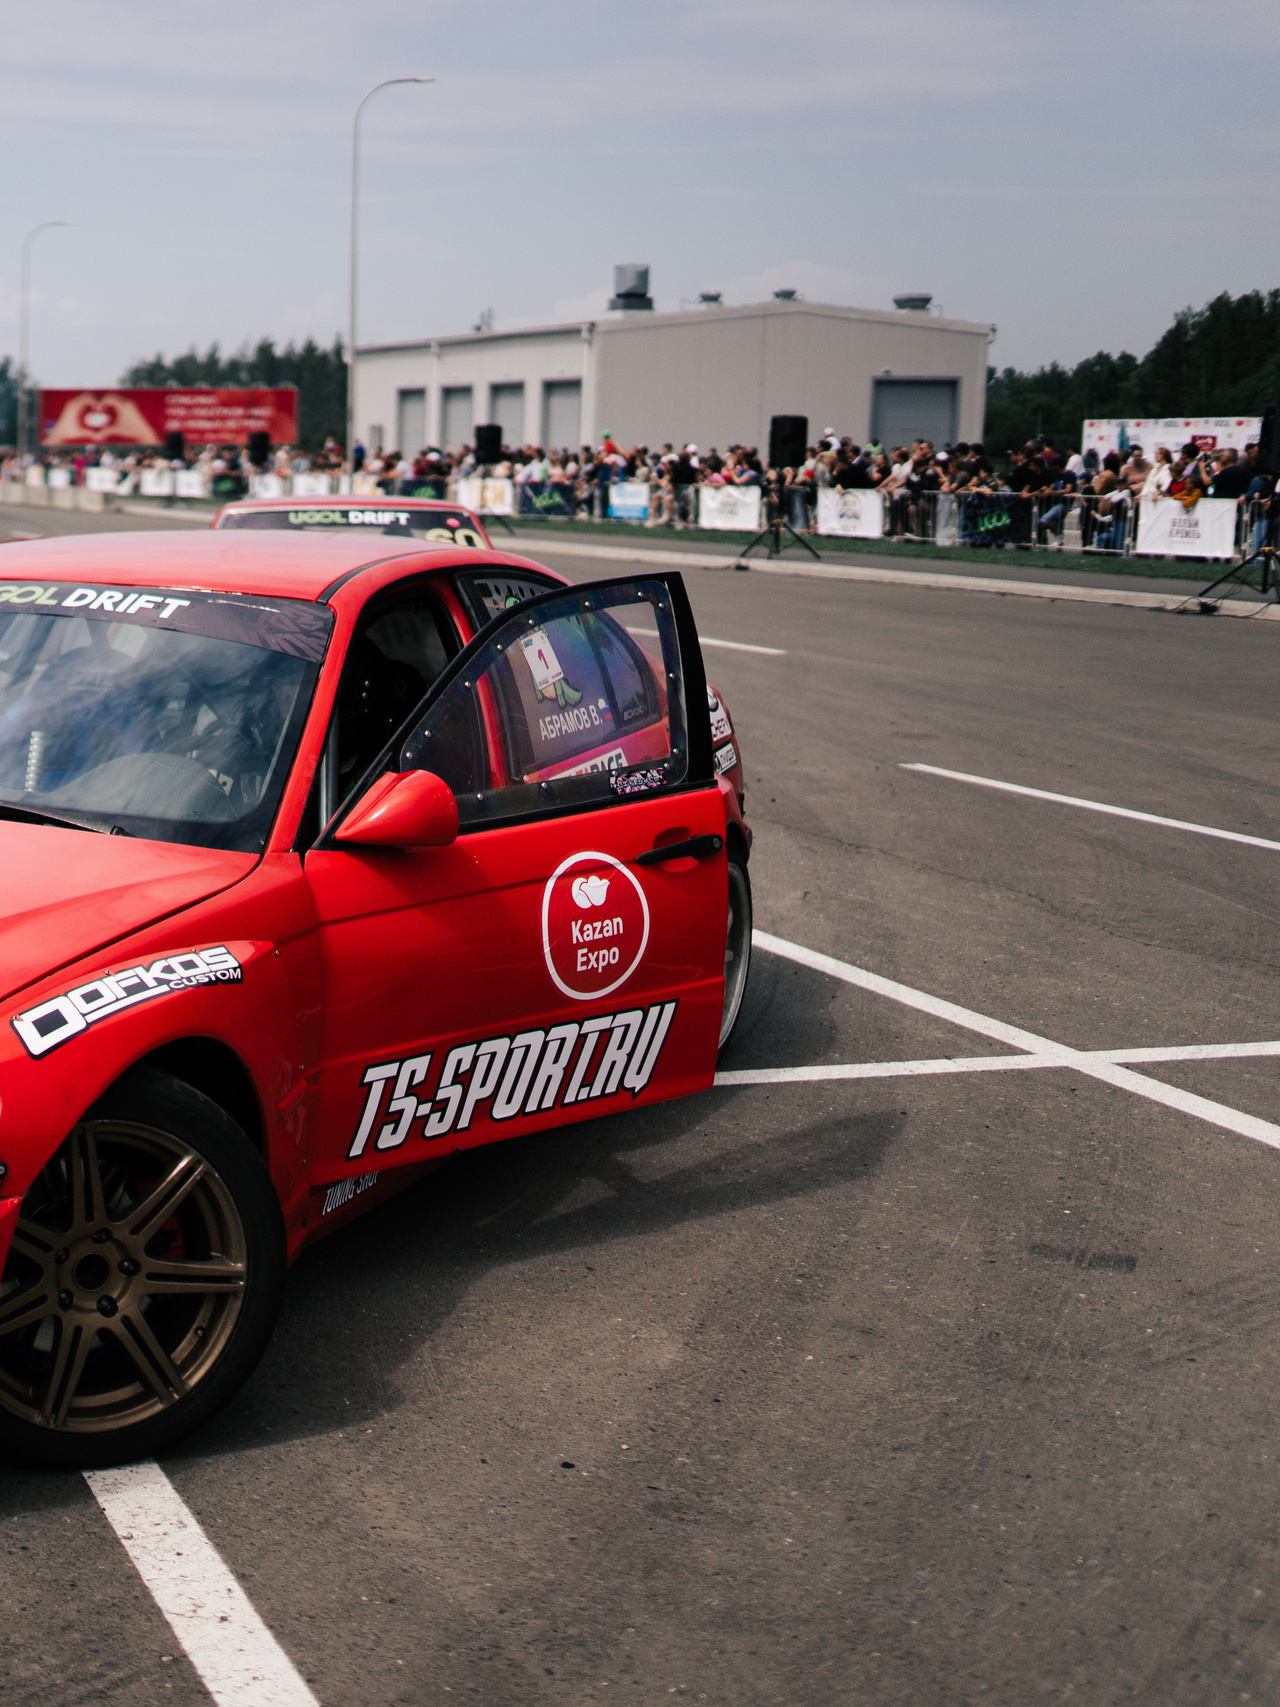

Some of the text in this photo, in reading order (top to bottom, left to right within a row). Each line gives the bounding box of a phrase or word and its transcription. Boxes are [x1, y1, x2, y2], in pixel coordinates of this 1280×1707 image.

[288, 511, 410, 526] UGOL DRIFT
[61, 588, 190, 619] DRIFT
[539, 707, 591, 741] АБРАМОВ
[571, 916, 624, 944] Kazan
[576, 946, 620, 973] Expo
[169, 968, 241, 989] CUSTOM
[322, 1177, 357, 1216] TUNING
